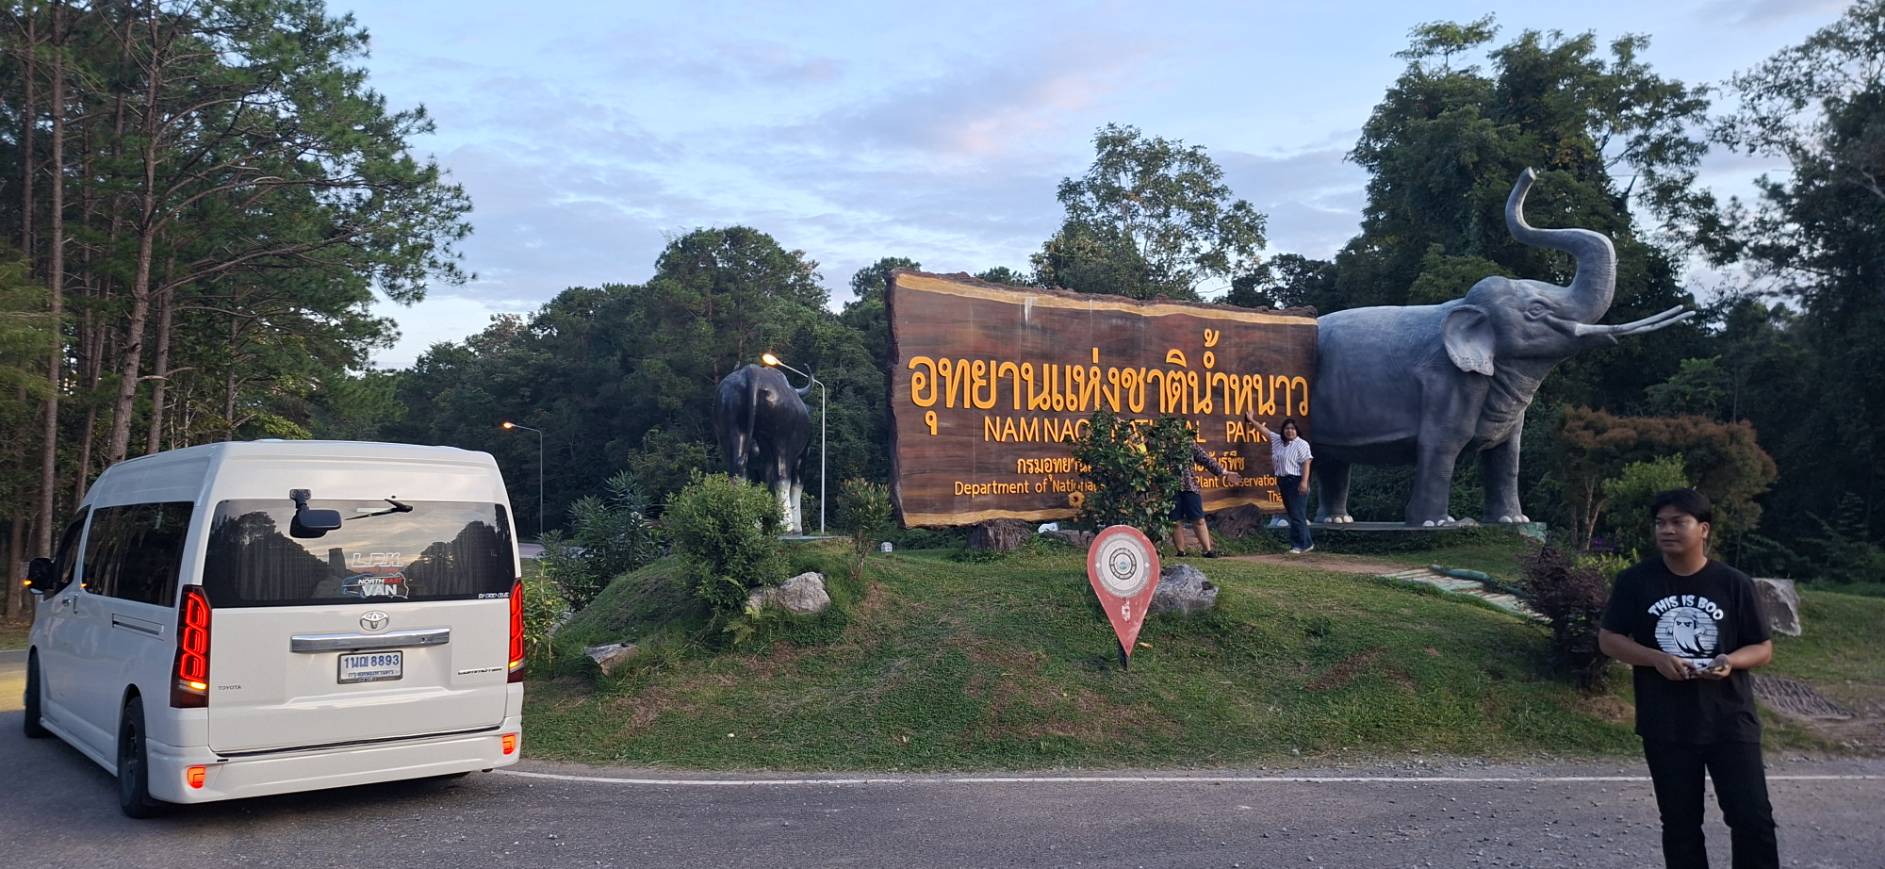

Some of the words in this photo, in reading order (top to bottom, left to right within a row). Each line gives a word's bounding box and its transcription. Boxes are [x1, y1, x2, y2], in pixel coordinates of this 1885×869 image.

[908, 328, 1309, 436] อุทยานแห่งชาติน้ำหนาว
[984, 416, 1039, 442] NAM
[955, 481, 1029, 498] Department
[1035, 478, 1047, 493] of
[361, 583, 398, 597] VAN
[1647, 595, 1679, 616] THIS
[1681, 594, 1695, 607] IS
[1697, 596, 1724, 620] BOO
[370, 654, 400, 667] 8893
